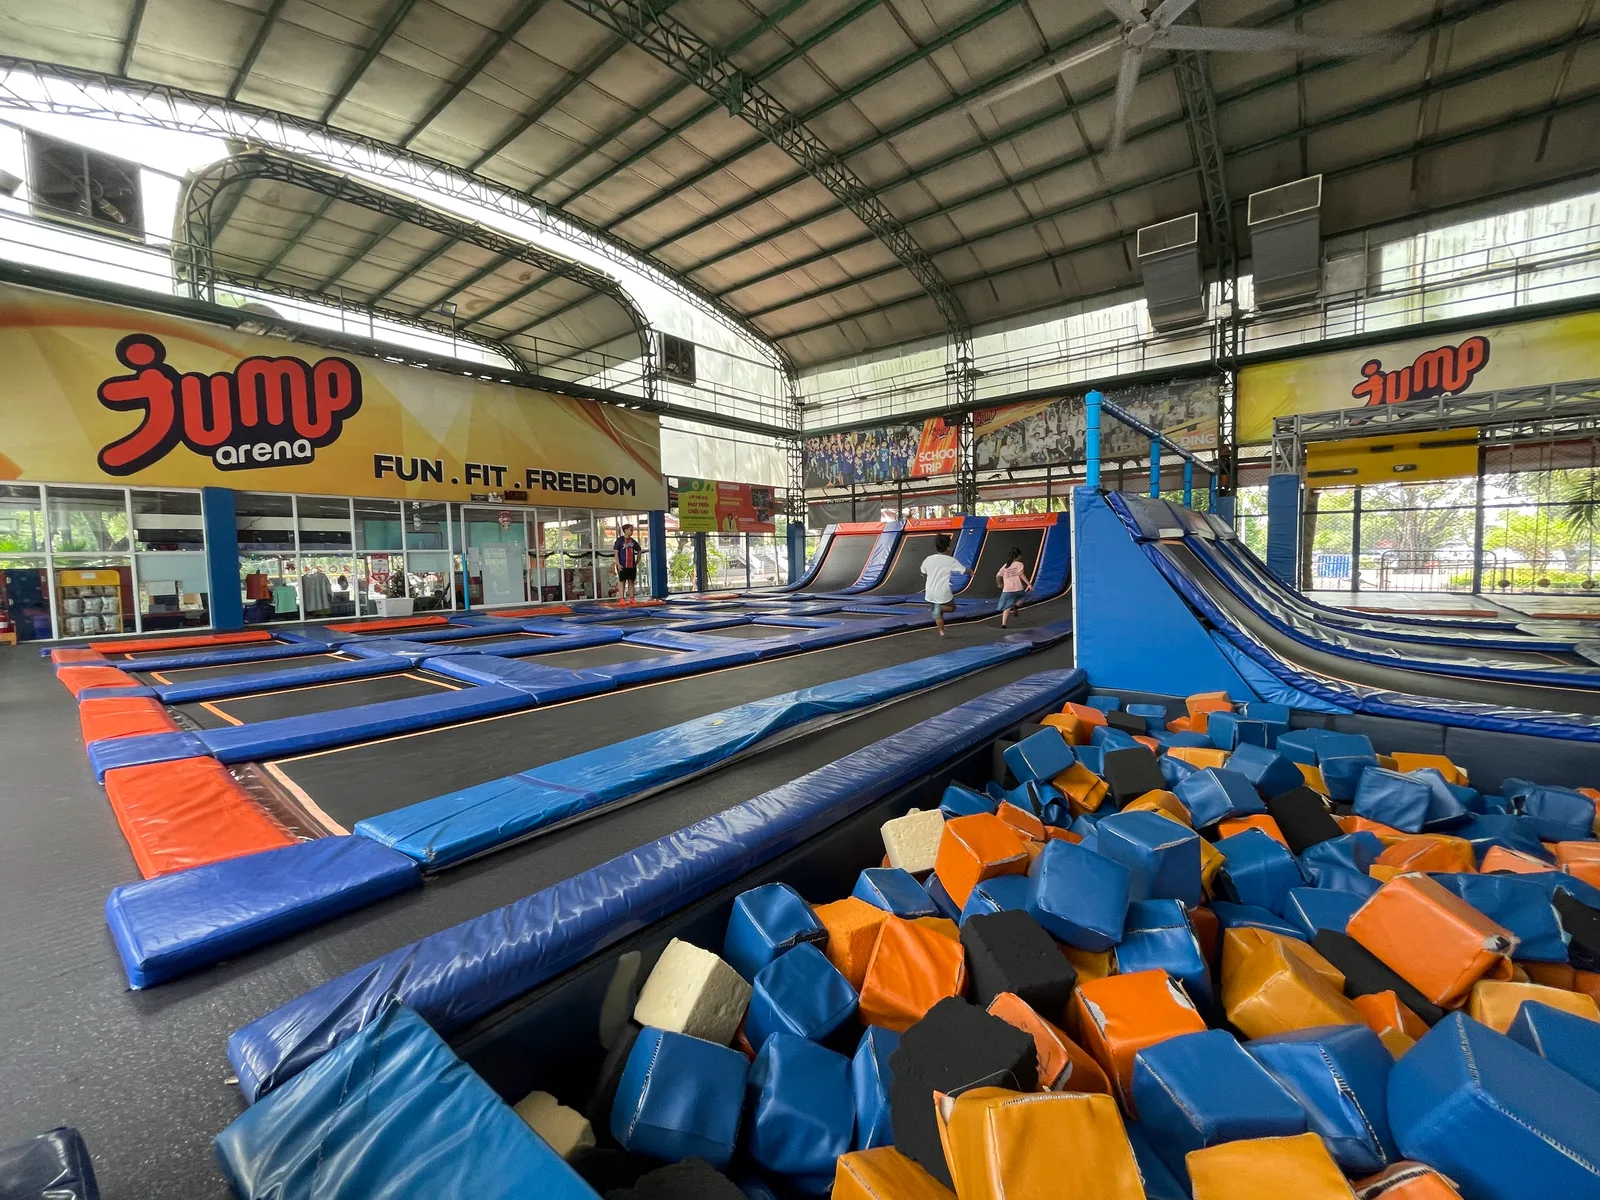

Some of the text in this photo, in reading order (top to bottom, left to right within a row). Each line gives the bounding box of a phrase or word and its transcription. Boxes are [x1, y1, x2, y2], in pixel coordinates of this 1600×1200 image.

[1352, 336, 1488, 408] jump
[99, 335, 360, 472] jump
[215, 437, 312, 465] arena
[919, 462, 942, 474] TRIP
[374, 454, 443, 483] FUN
[465, 463, 508, 487] FIT
[526, 468, 636, 497] FREEDOM
